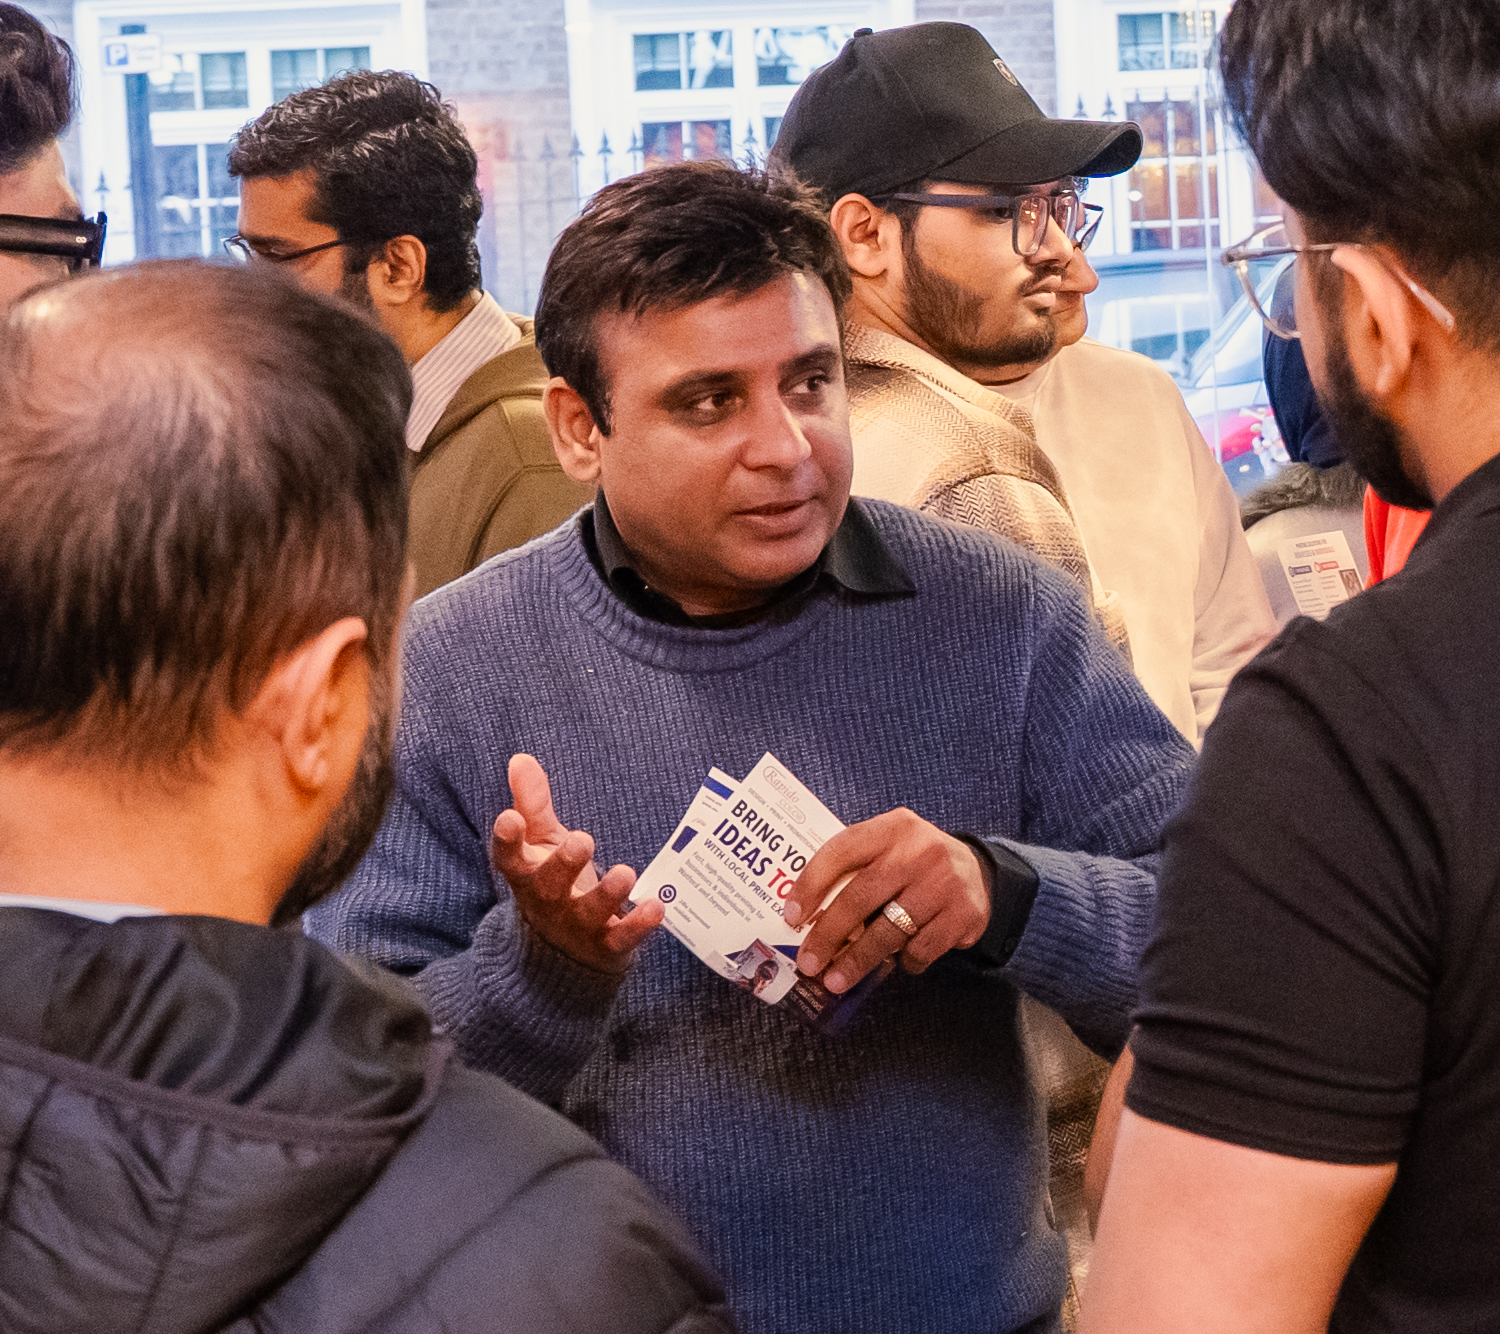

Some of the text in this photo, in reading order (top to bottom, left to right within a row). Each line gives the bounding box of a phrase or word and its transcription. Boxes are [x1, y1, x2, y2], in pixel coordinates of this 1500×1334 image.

[703, 837, 725, 860] WITH
[722, 857, 749, 884] LOCAL
[747, 880, 773, 903] PRINT
[712, 818, 798, 899] IDEAS TO
[730, 799, 784, 852] BRING
[781, 843, 806, 872] YO
[786, 822, 816, 853] PROMOTIONA
